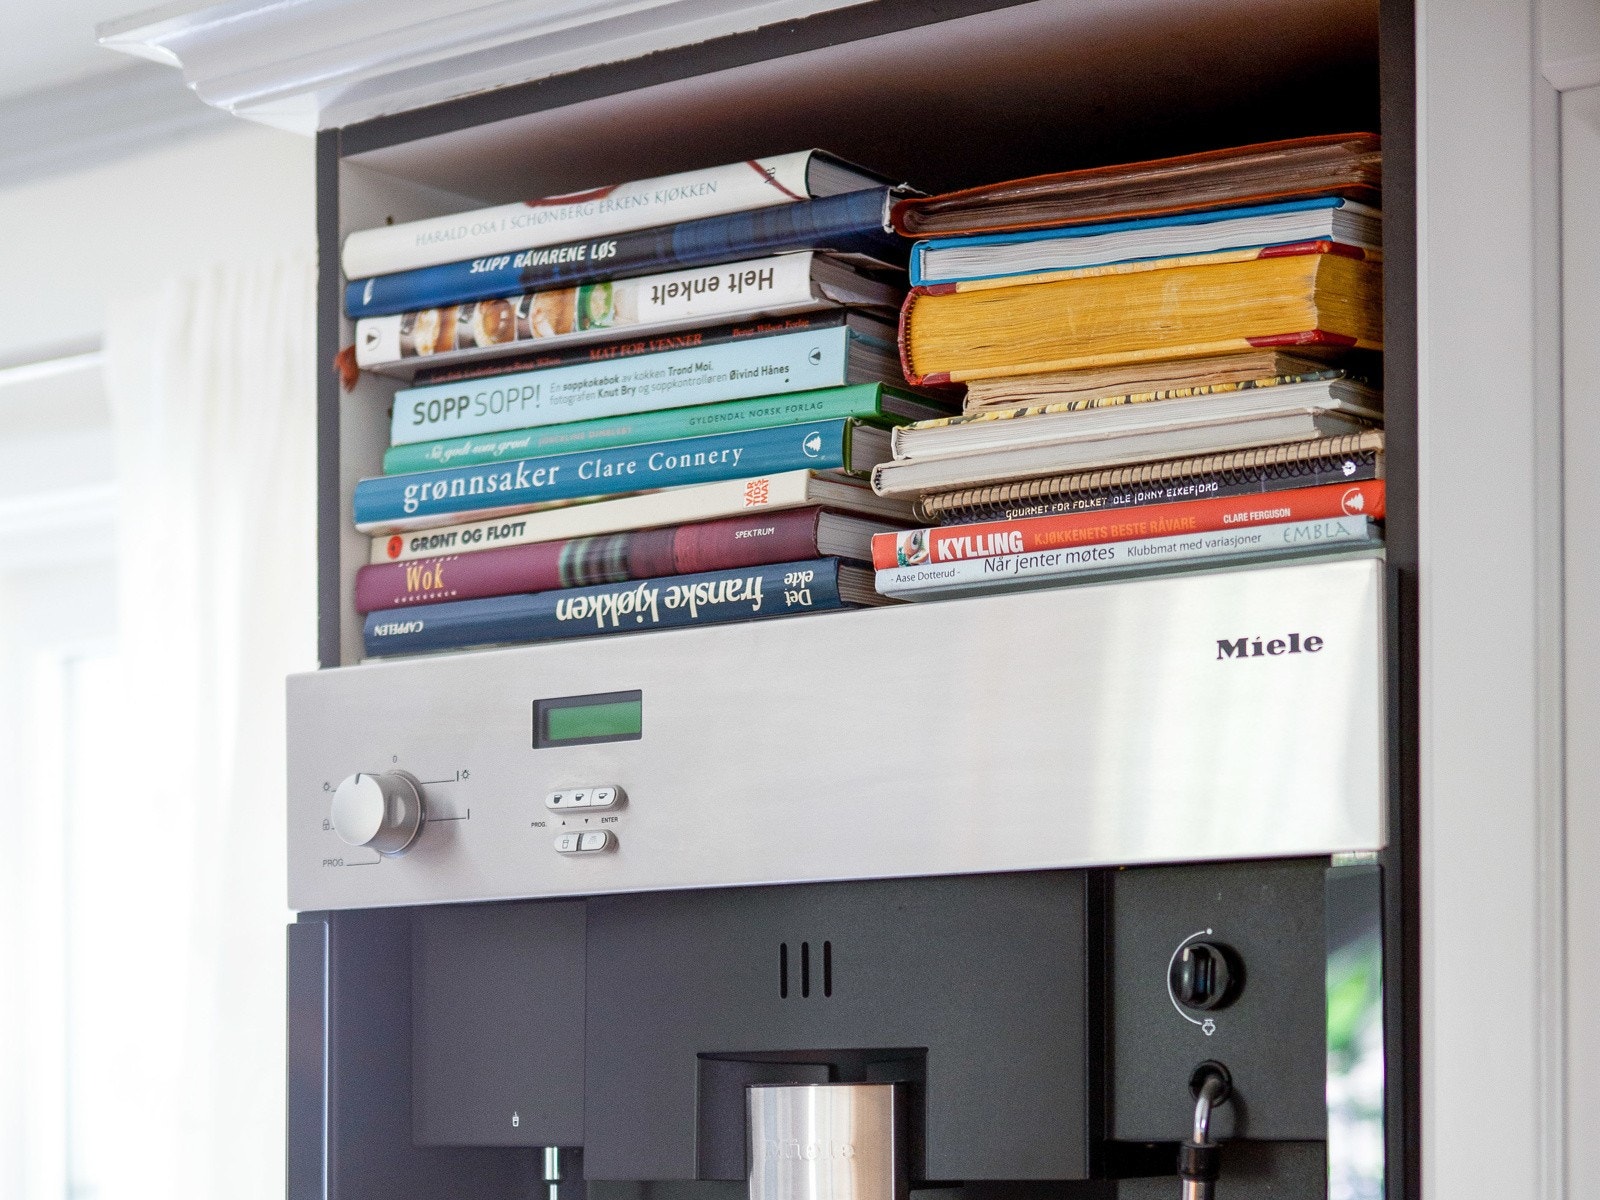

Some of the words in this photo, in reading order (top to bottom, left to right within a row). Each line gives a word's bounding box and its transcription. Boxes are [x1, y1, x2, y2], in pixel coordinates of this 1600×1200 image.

[416, 224, 468, 246] HARALD
[472, 221, 497, 237] OSA
[599, 192, 650, 214] ERKENS
[654, 180, 719, 203] KJØKKEN
[469, 252, 509, 274] SLIPP
[513, 244, 587, 269] RÅVARENE
[590, 240, 618, 261] LØS
[651, 276, 720, 306] enkelt
[728, 267, 774, 294] Helt
[589, 346, 617, 362] MAT
[619, 341, 646, 358] FOR
[650, 332, 704, 352] VENNER
[597, 386, 619, 400] Knut
[621, 383, 637, 399] Bry
[729, 366, 760, 382] Øivind
[761, 364, 790, 379] Hånes
[668, 362, 693, 377] Trond
[413, 395, 471, 426] SOPP
[474, 384, 541, 417] SOPP!
[689, 411, 745, 426] GYLDENDAL
[749, 406, 782, 419] NORSK
[785, 401, 824, 414] FORLAG
[577, 457, 637, 481] Clare
[648, 447, 744, 473] Connery
[404, 461, 560, 513] grønnsaker
[1112, 493, 1131, 505] OLE
[1051, 502, 1070, 513] FOR
[1072, 496, 1108, 509] FOLKET
[1223, 511, 1249, 524] CLARE
[1250, 508, 1291, 521] FERGUSON
[409, 532, 458, 552] GRØNT
[461, 528, 483, 544] OG
[486, 521, 527, 540] FLOTT
[735, 526, 775, 539] SPEKTRUM
[1034, 525, 1108, 546] KJØKKENETS
[1110, 518, 1147, 537] BESTE
[1150, 514, 1197, 533] RÅVARE
[1283, 521, 1351, 544] EMBLA
[937, 530, 1024, 561] KYLLING
[1127, 542, 1178, 558] Klubbmat
[1180, 538, 1203, 552] med
[1205, 533, 1262, 550] variasjoner
[984, 556, 1012, 574] Når
[1013, 551, 1062, 575] jenter
[1065, 546, 1116, 564] møtes
[405, 561, 445, 593] Wok
[784, 570, 814, 589] ekte
[895, 572, 916, 584] Aase
[917, 568, 956, 582] Dotterud
[555, 582, 660, 629] kjøkken
[664, 576, 764, 618] franske
[784, 588, 813, 607] Det
[373, 619, 424, 637] CAPPELEN
[1216, 633, 1324, 660] Miele
[601, 816, 619, 824] ENTER
